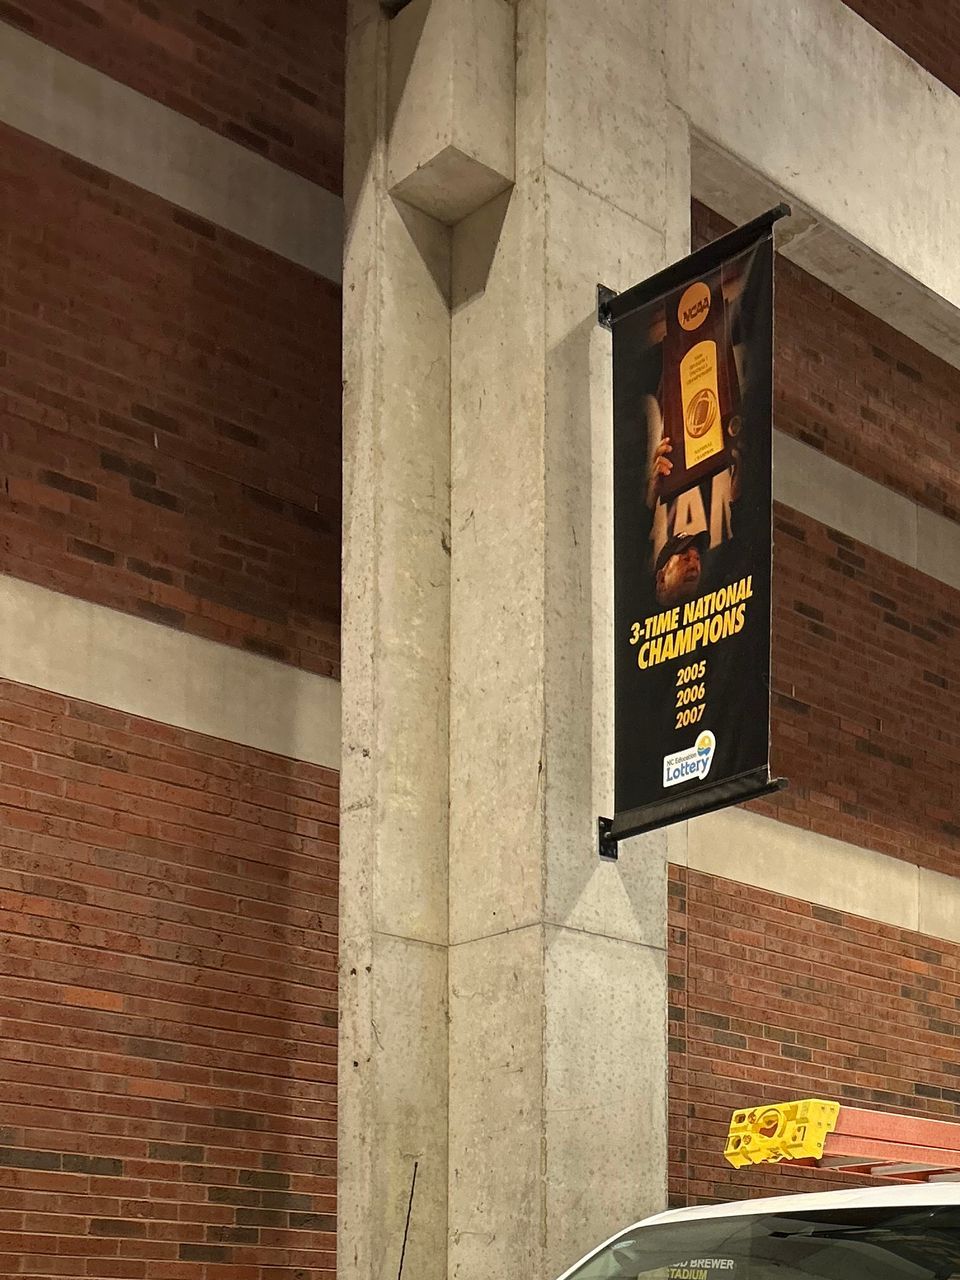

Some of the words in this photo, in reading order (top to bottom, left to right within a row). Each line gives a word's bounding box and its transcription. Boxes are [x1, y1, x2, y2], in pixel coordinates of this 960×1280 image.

[683, 297, 709, 322] NCAA
[629, 606, 680, 645] 3-TIME
[683, 574, 753, 625] NATIONAL
[637, 602, 746, 670] CHAMPIONS
[675, 659, 707, 687] 2005
[675, 681, 706, 708] 2006
[674, 702, 706, 730] 2007
[666, 756, 710, 782] Lottery
[690, 1258, 734, 1270] BREWER
